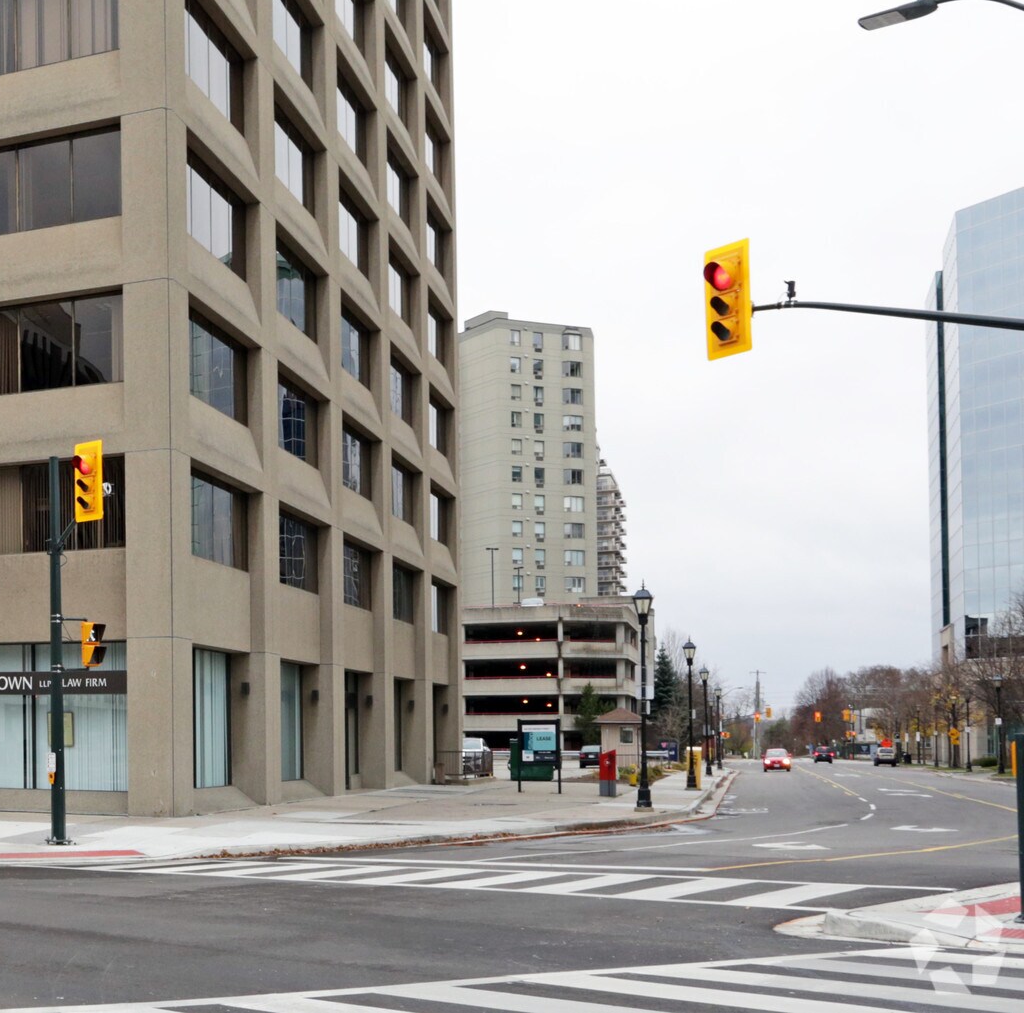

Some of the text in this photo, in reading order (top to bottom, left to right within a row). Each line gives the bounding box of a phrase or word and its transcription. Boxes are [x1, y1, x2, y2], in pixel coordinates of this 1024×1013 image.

[39, 680, 52, 688] LLP
[61, 678, 82, 688] LAW
[85, 678, 107, 687] FIRM
